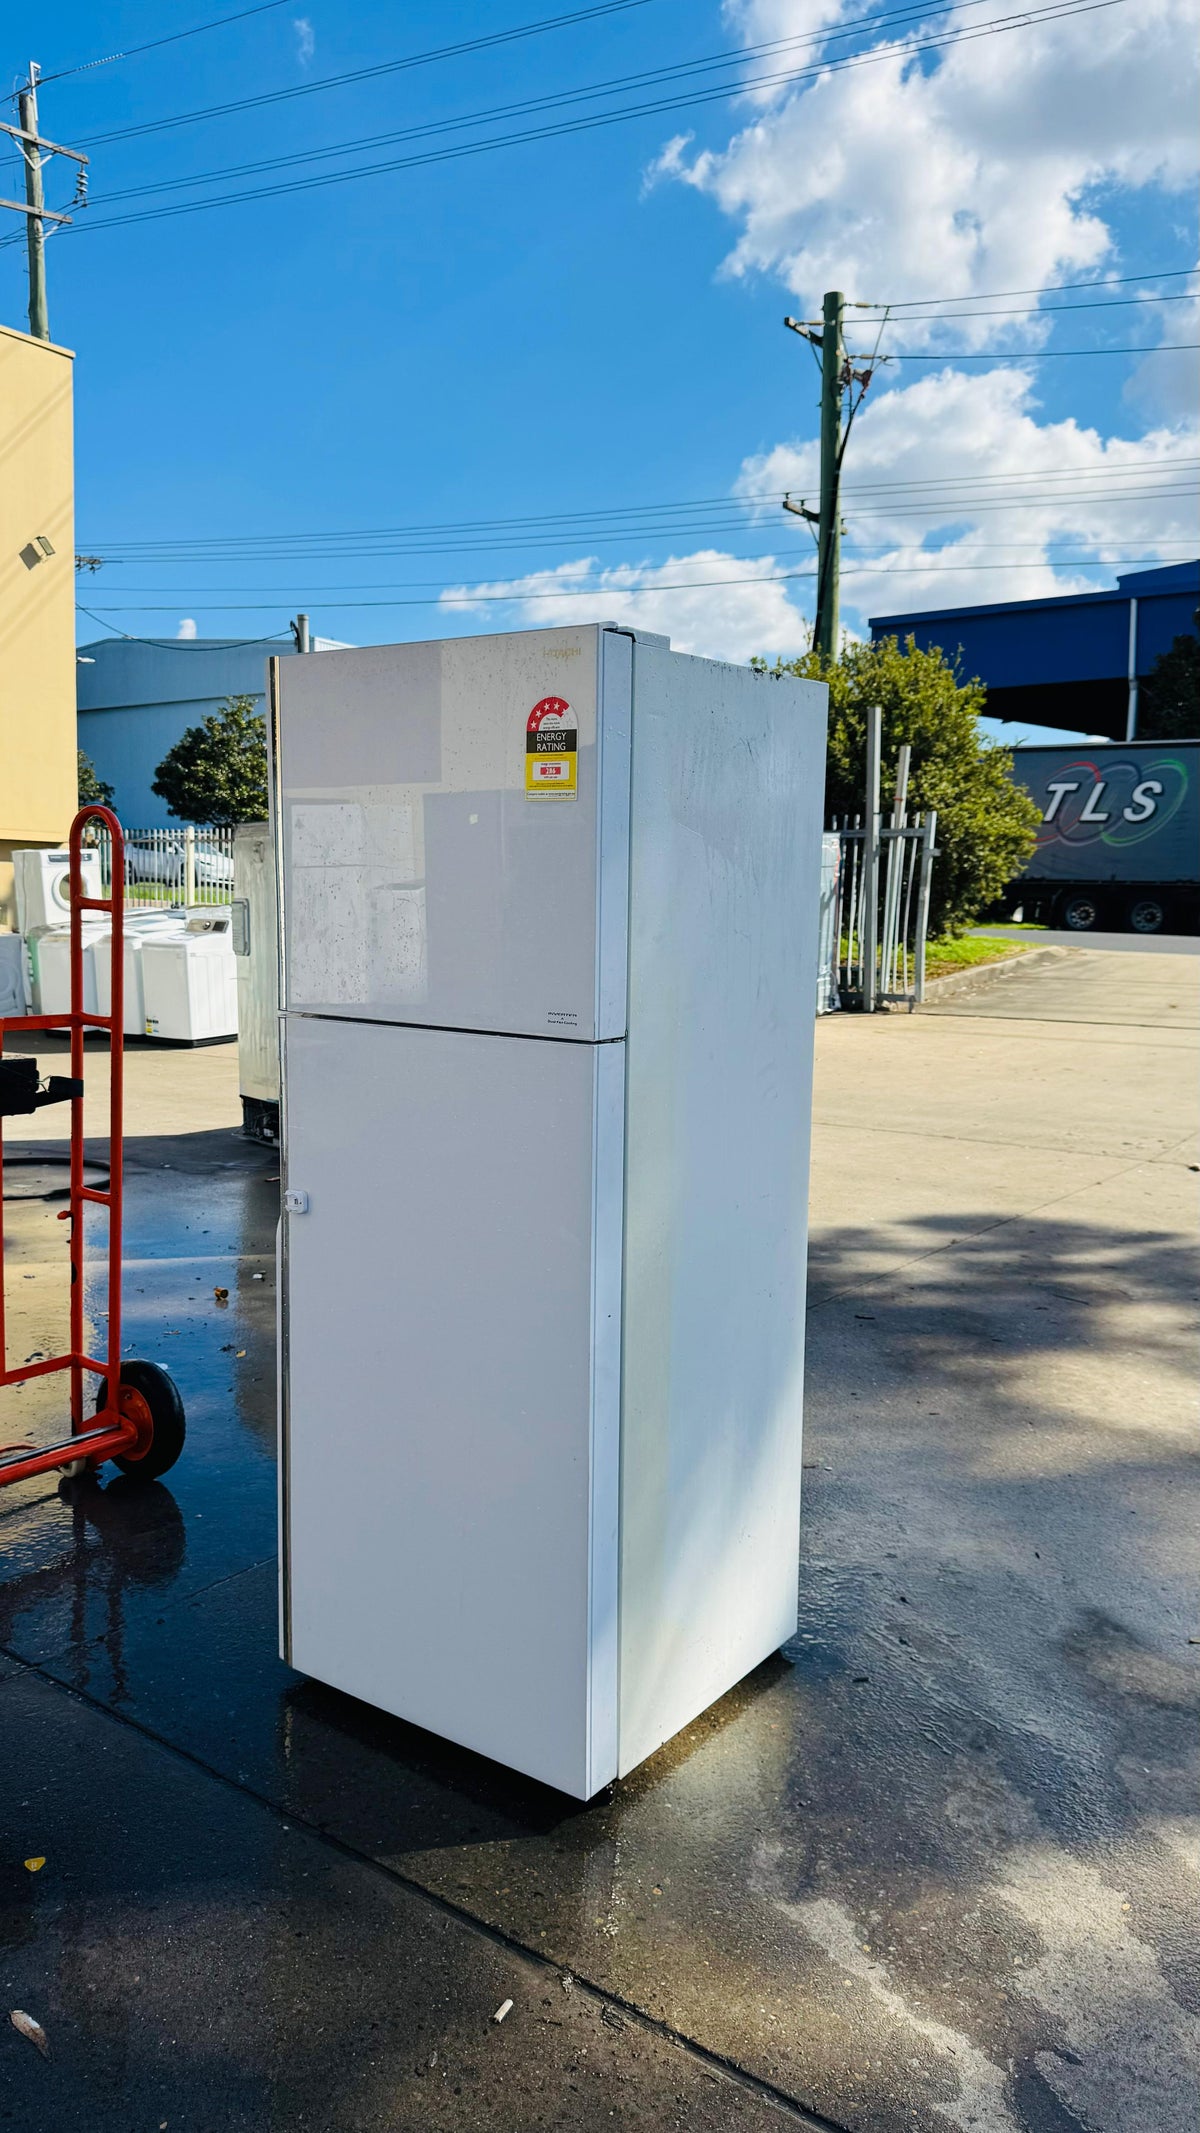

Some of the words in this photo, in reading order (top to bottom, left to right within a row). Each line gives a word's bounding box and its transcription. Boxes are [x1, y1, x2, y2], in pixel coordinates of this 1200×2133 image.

[536, 732, 567, 742] ENERGY
[536, 742, 566, 752] RATING
[1043, 780, 1163, 822] TLS
